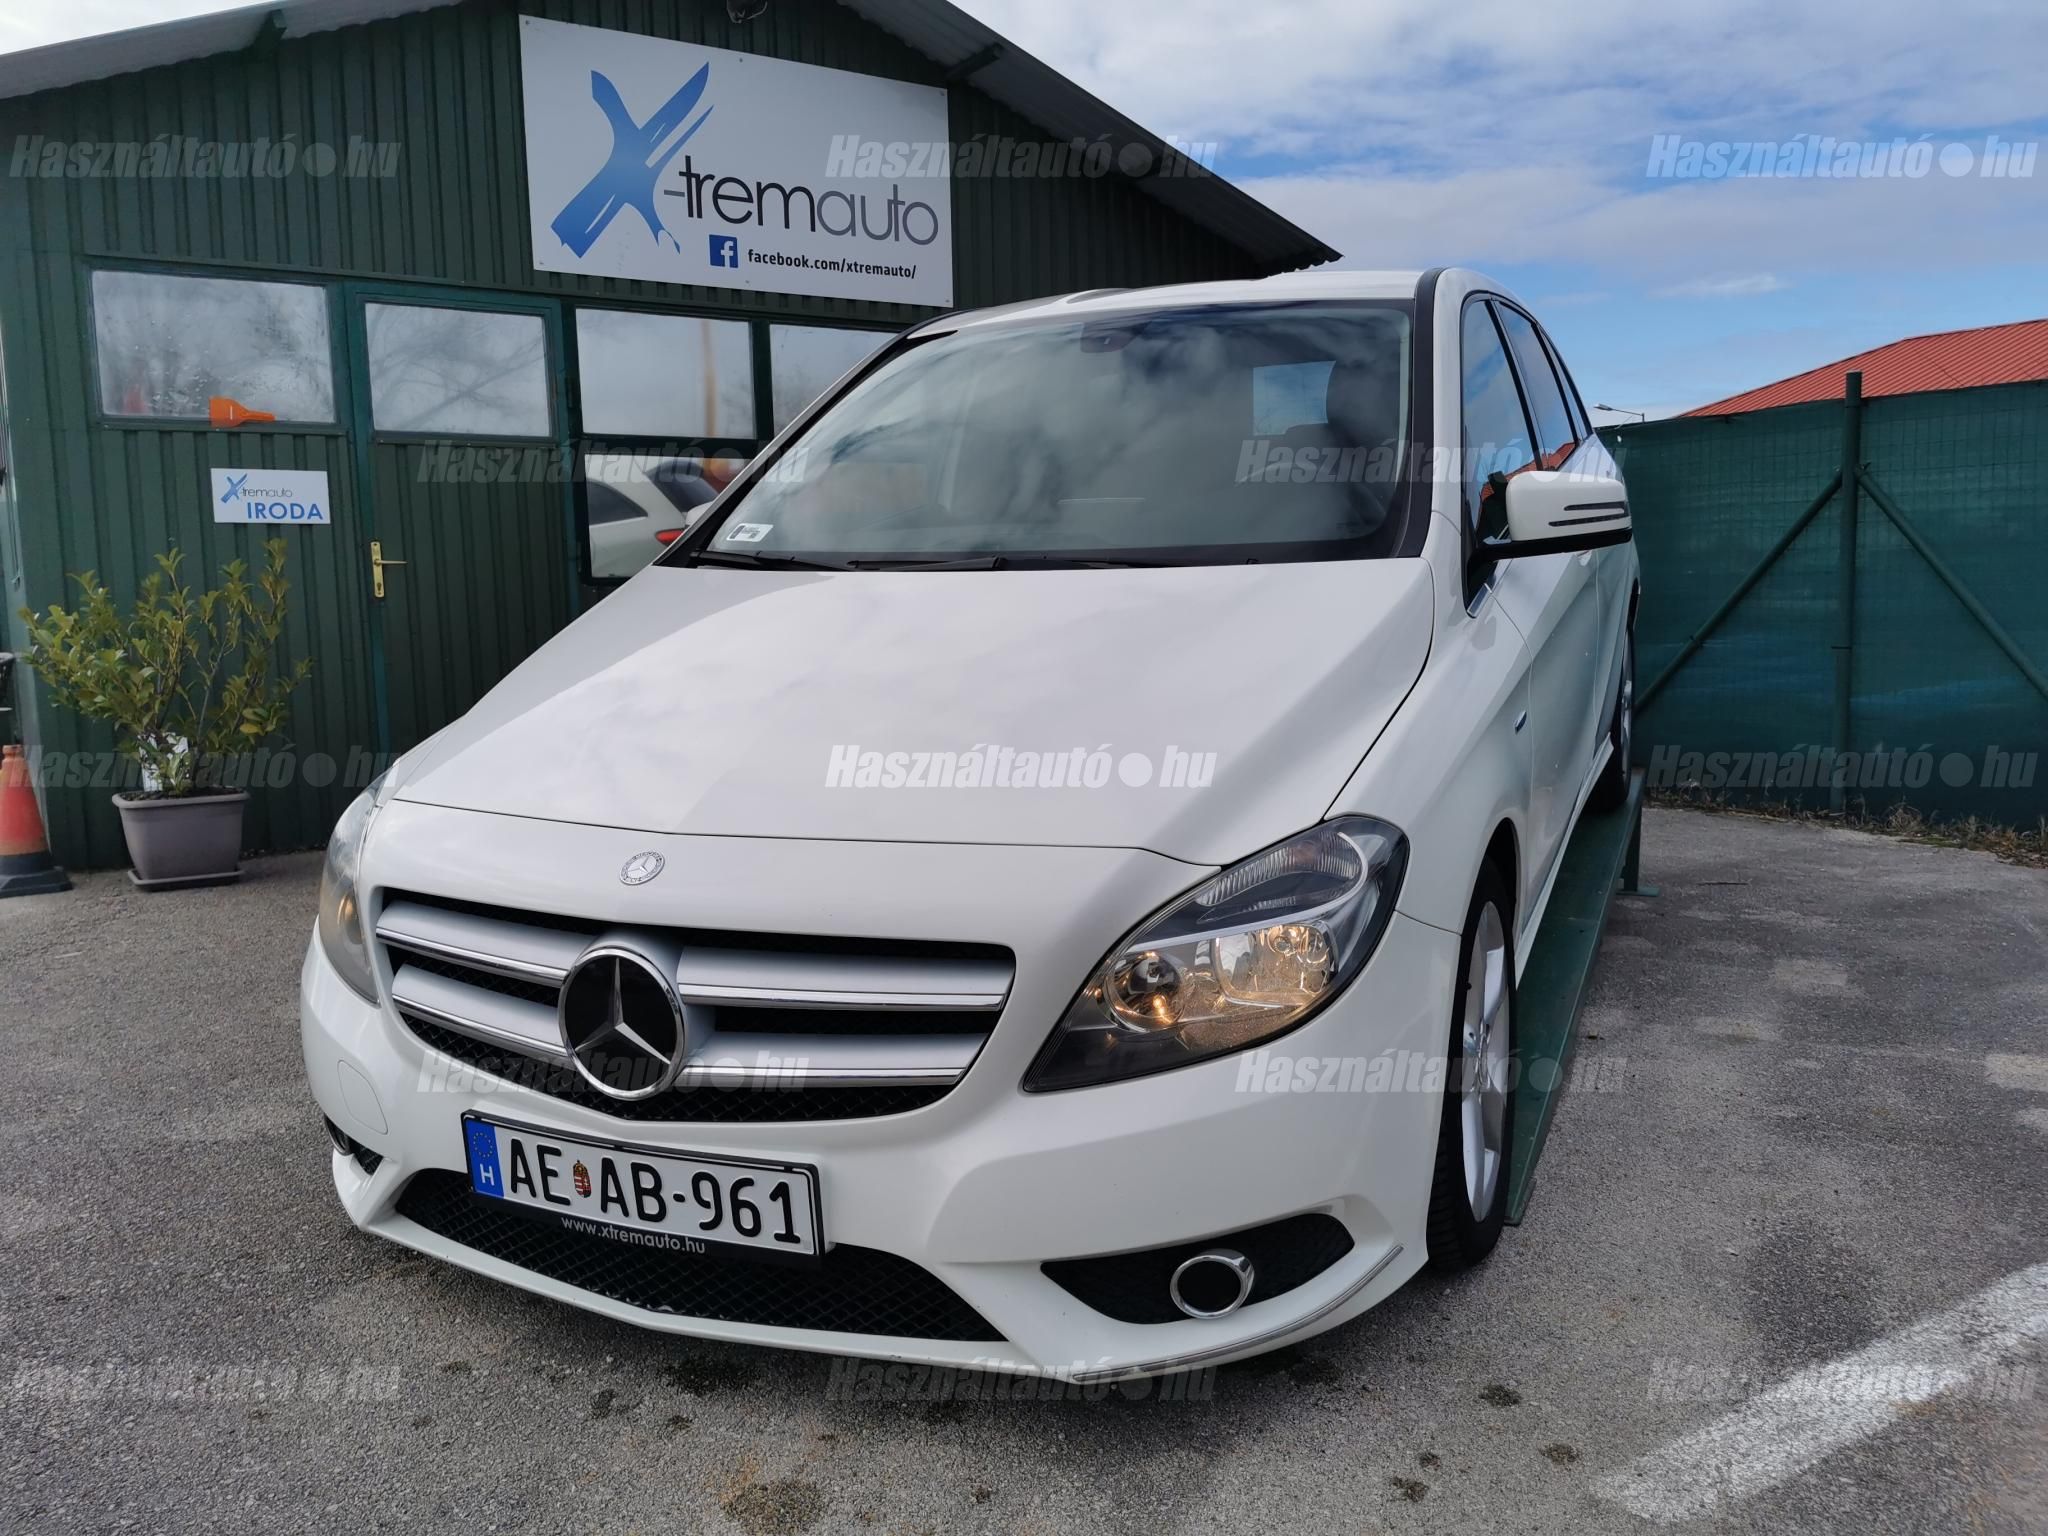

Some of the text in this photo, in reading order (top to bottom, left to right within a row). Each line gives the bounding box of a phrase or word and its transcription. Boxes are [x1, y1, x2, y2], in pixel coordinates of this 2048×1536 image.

[748, 249, 917, 279] facebook.com/xtremauto/
[247, 502, 323, 519] IRODA
[480, 1163, 495, 1186] H
[510, 1138, 801, 1244] AE AB-961
[561, 1217, 705, 1254] www.xtremauto.hu
